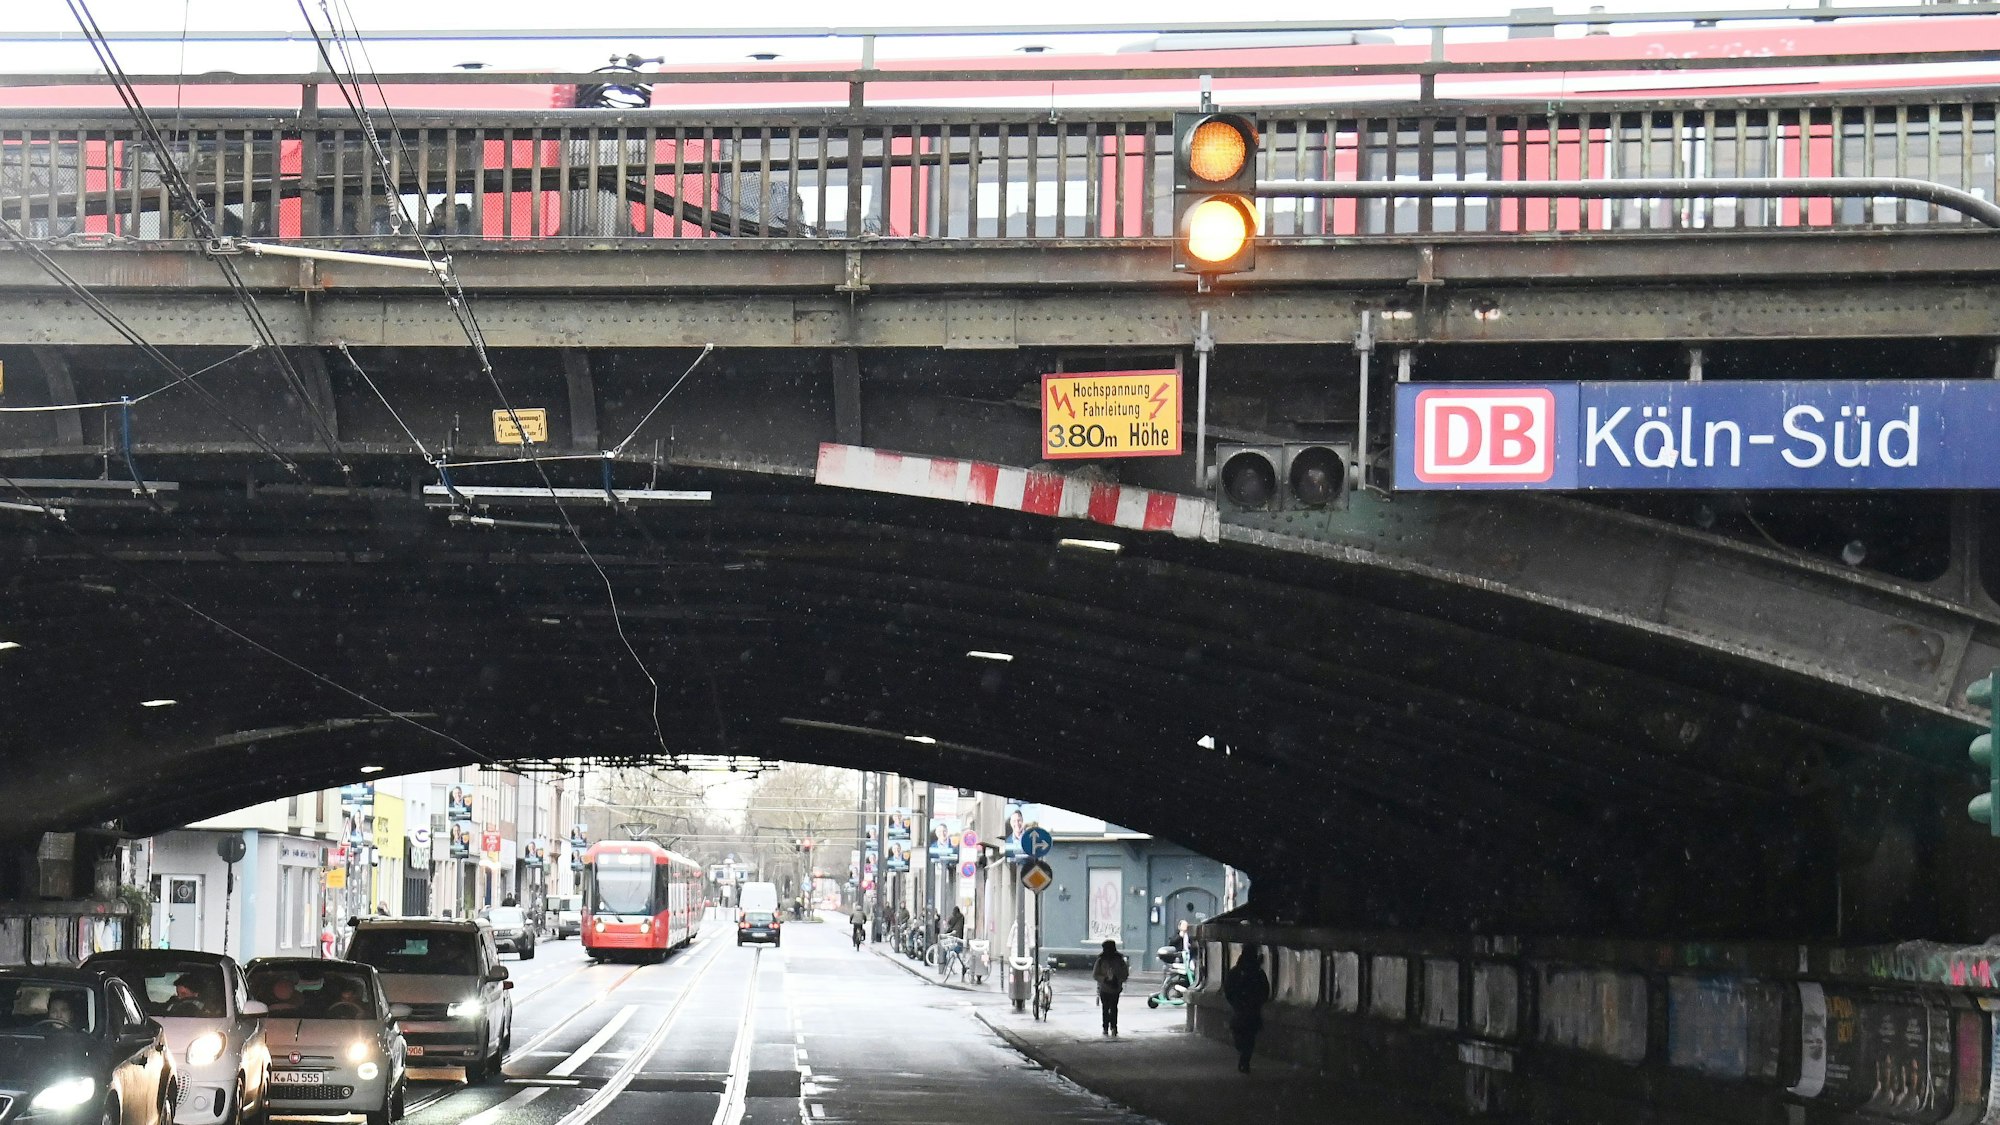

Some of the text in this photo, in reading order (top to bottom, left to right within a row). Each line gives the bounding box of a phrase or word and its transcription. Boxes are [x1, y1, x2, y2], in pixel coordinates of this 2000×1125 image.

[1073, 381, 1150, 399] Hochspannung
[1083, 401, 1140, 419] Fahrleitung
[1129, 422, 1169, 447] Höhe
[1434, 405, 1536, 466] DB
[1586, 404, 1919, 468] Köln-Süd
[301, 1072, 320, 1083] 555
